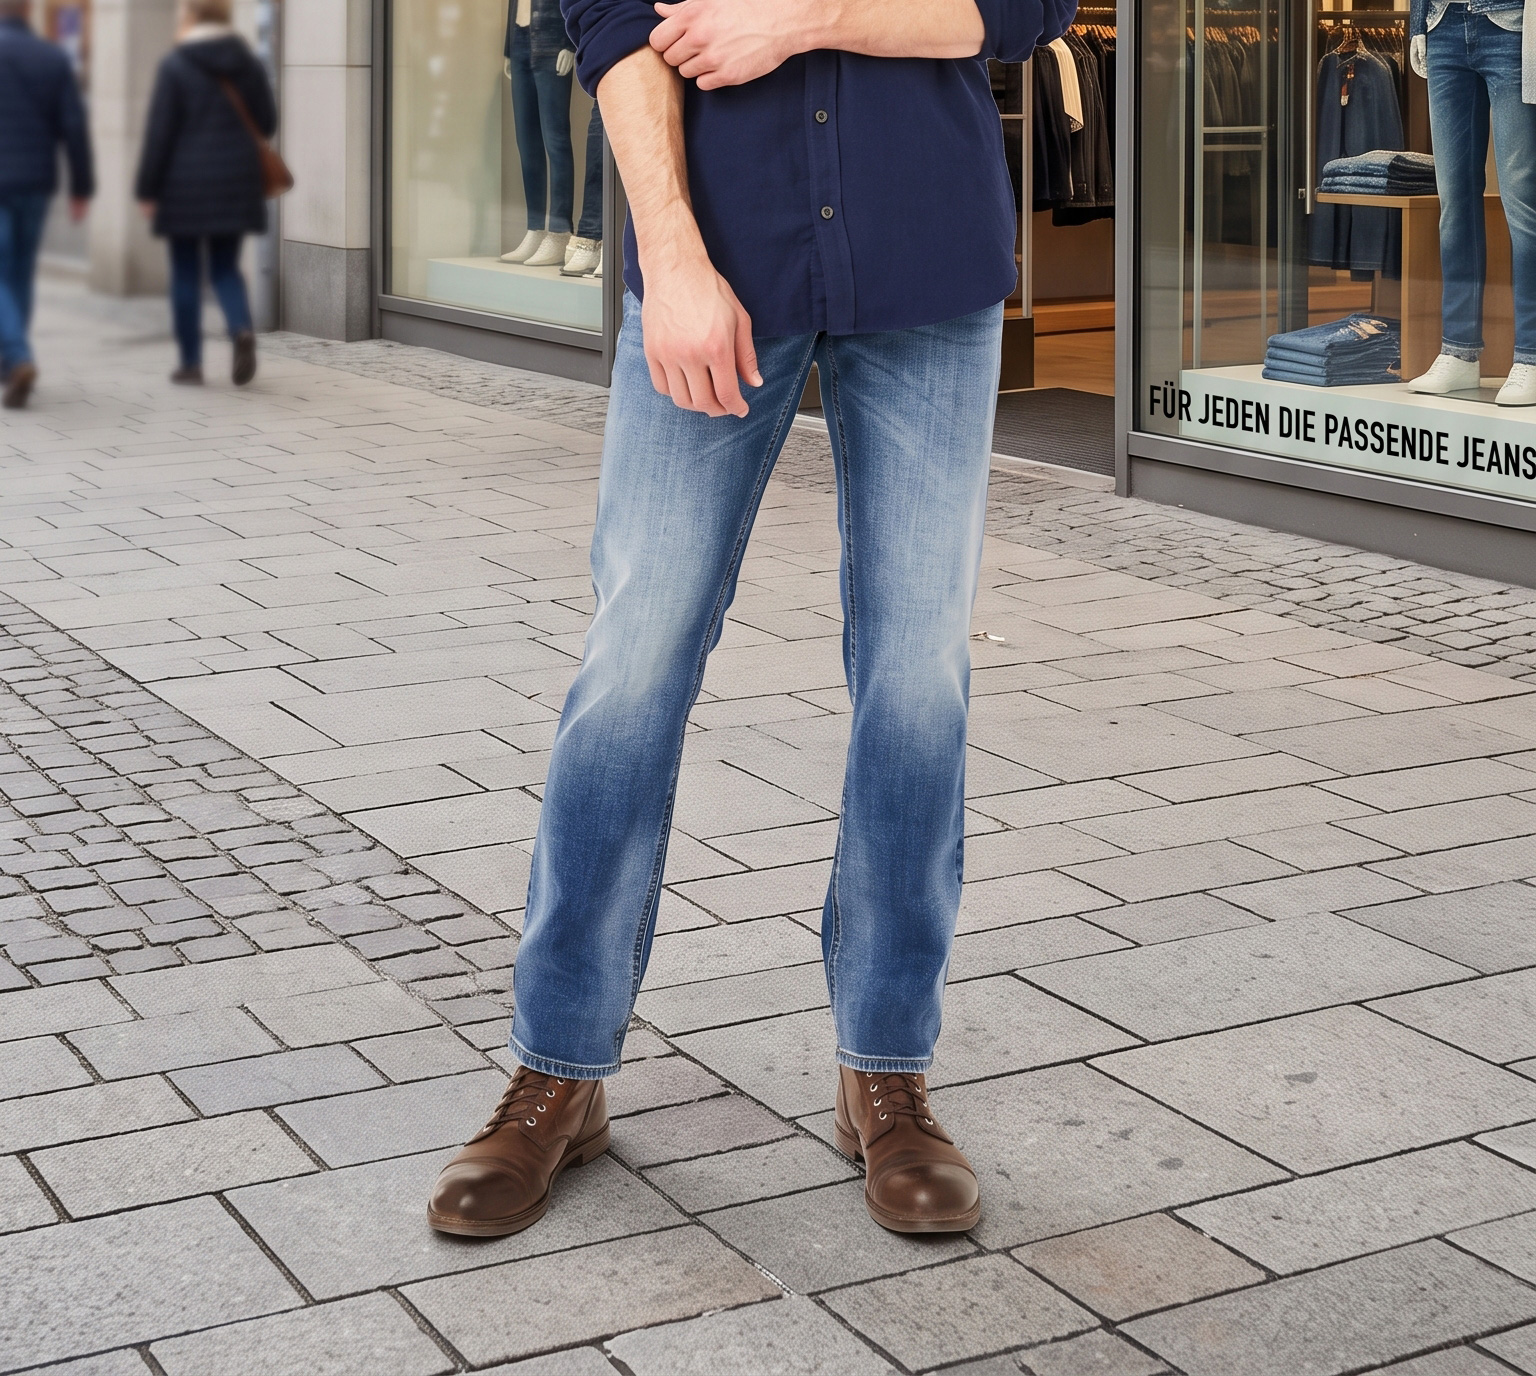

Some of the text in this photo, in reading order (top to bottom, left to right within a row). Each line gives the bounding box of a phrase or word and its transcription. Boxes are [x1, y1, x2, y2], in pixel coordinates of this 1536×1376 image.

[1149, 380, 1536, 480] FÜR JEDEN DIE PASSENDE JEANS
